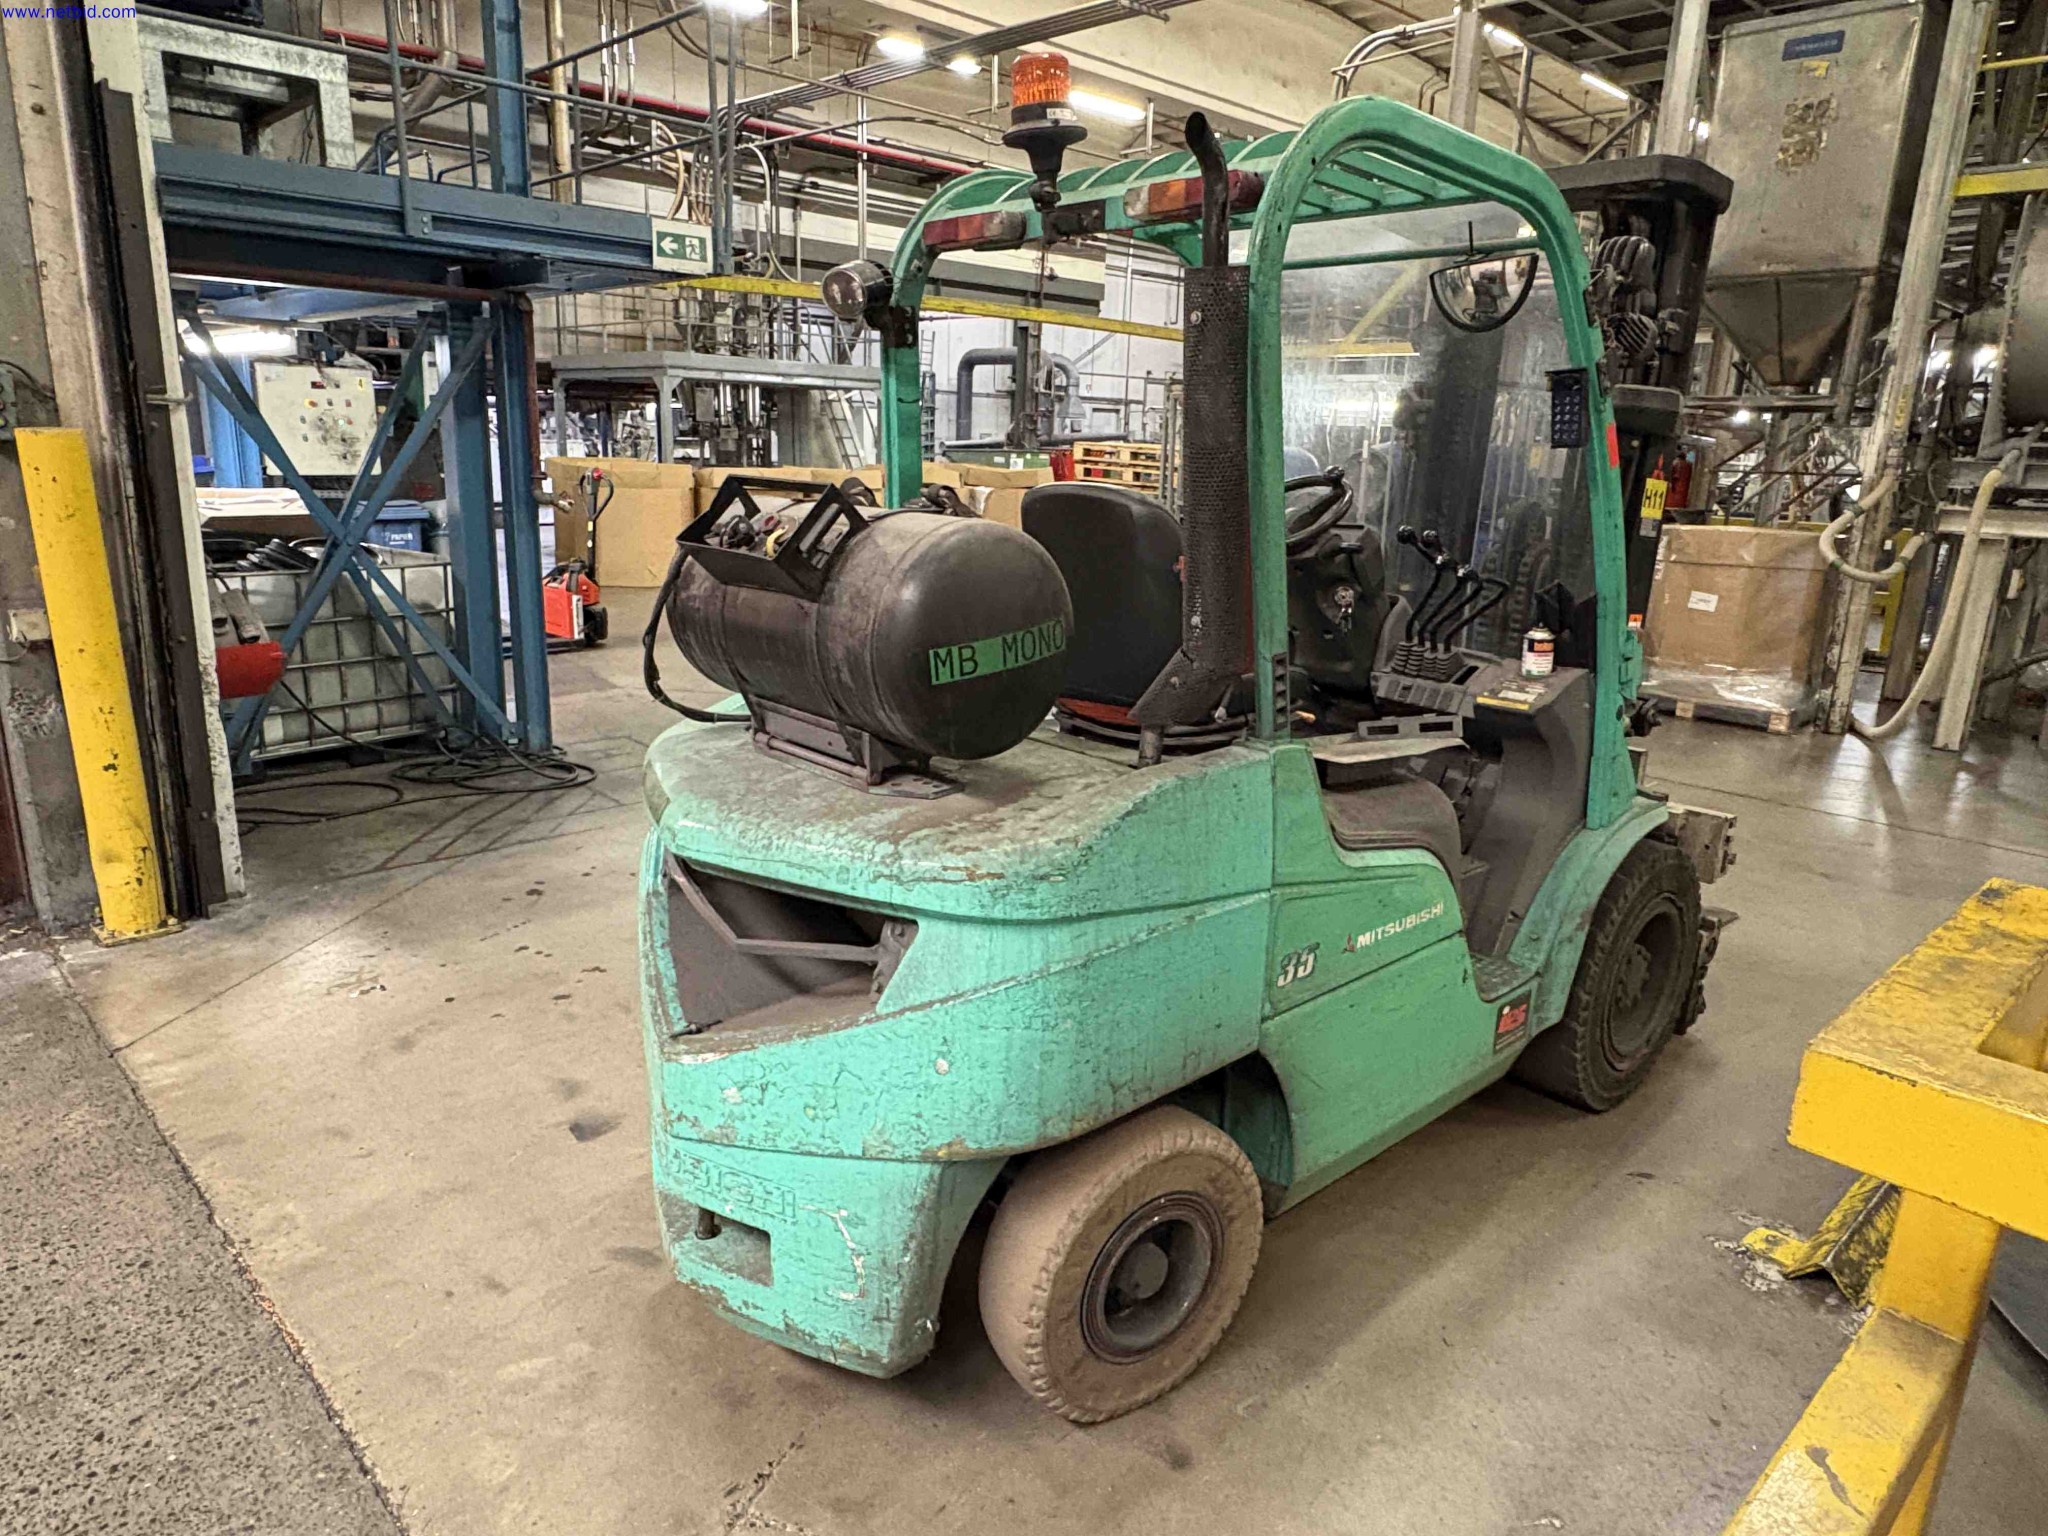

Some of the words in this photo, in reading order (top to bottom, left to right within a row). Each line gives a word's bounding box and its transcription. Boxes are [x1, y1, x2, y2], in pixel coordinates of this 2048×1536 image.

[1642, 487, 1665, 511] H11
[932, 645, 979, 682] MB
[1001, 619, 1065, 668] MONO
[1356, 901, 1445, 950] MITSUBISHI
[1276, 941, 1321, 988] 35
